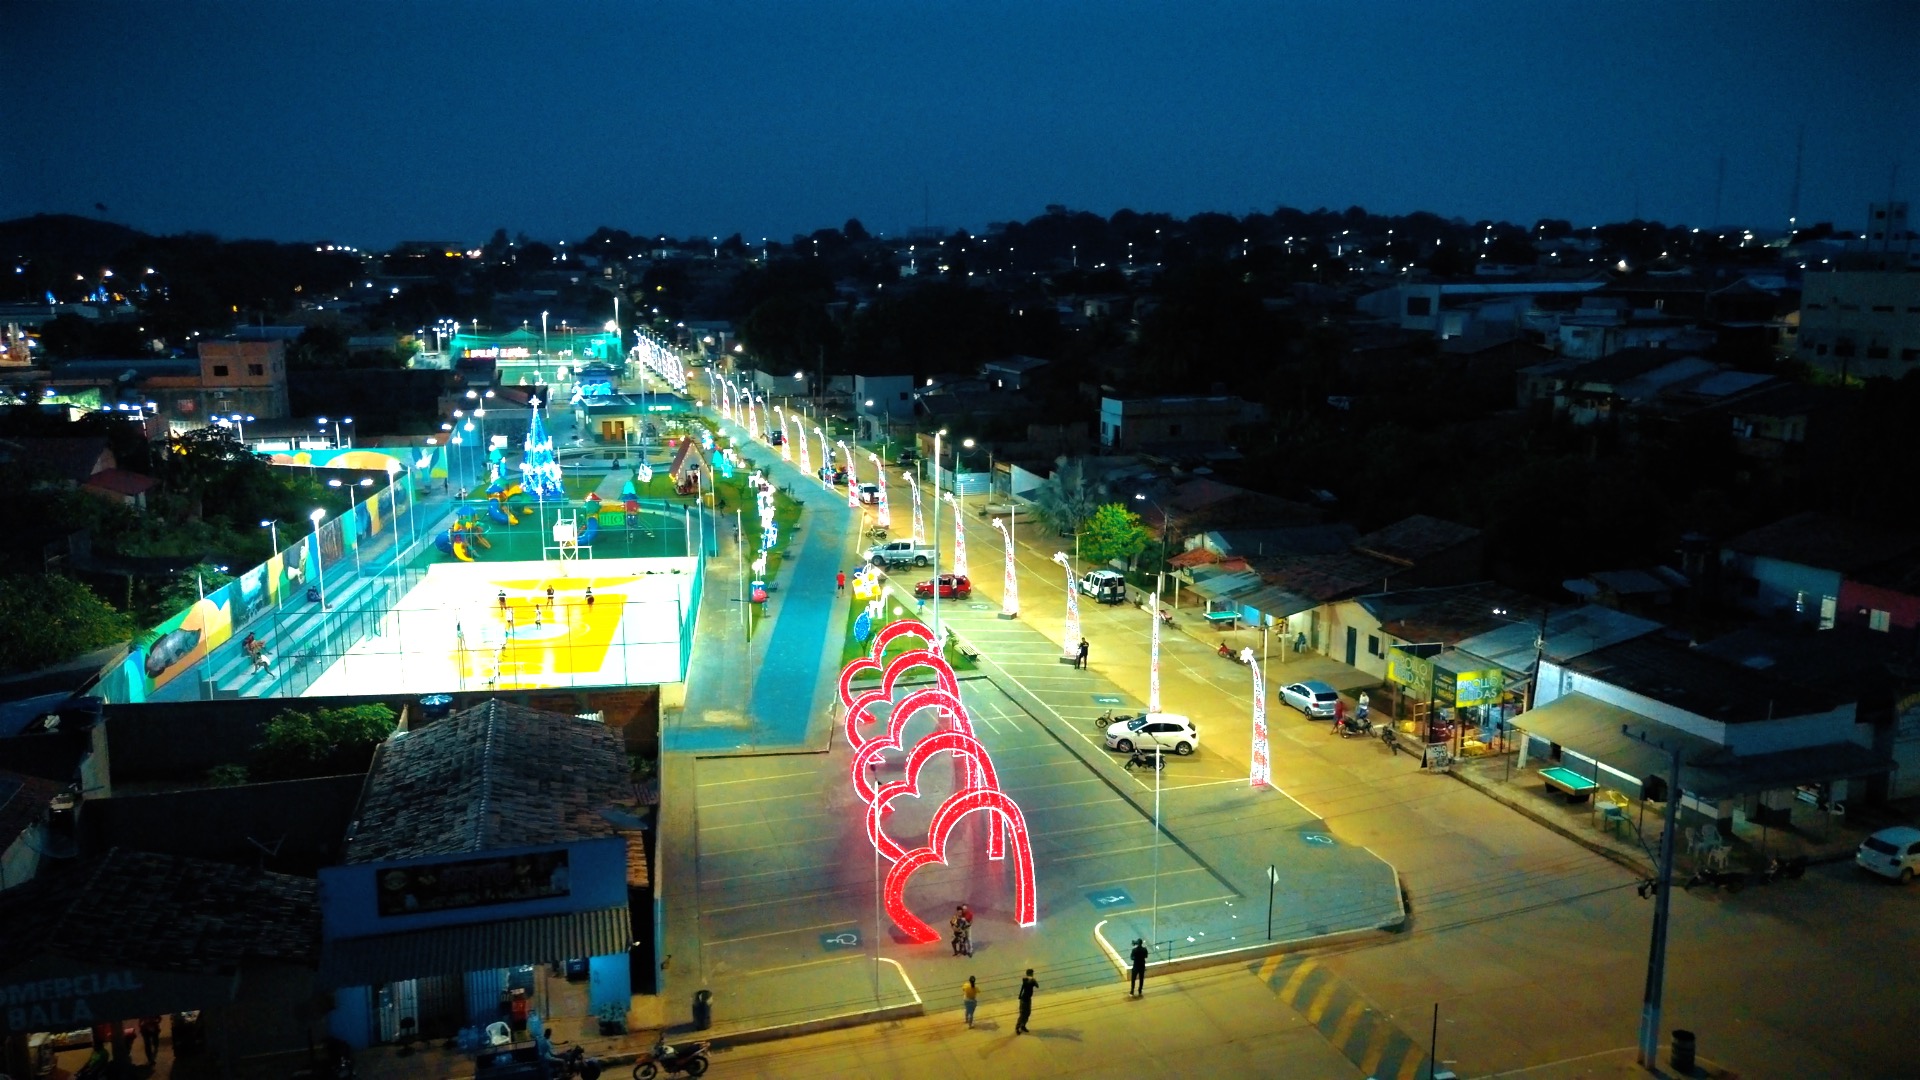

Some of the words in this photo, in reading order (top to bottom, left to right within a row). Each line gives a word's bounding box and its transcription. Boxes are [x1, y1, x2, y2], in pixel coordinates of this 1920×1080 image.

[1460, 677, 1498, 689] APOLLO
[1459, 688, 1497, 701] BEBIDAS
[8, 999, 94, 1031] BALA
